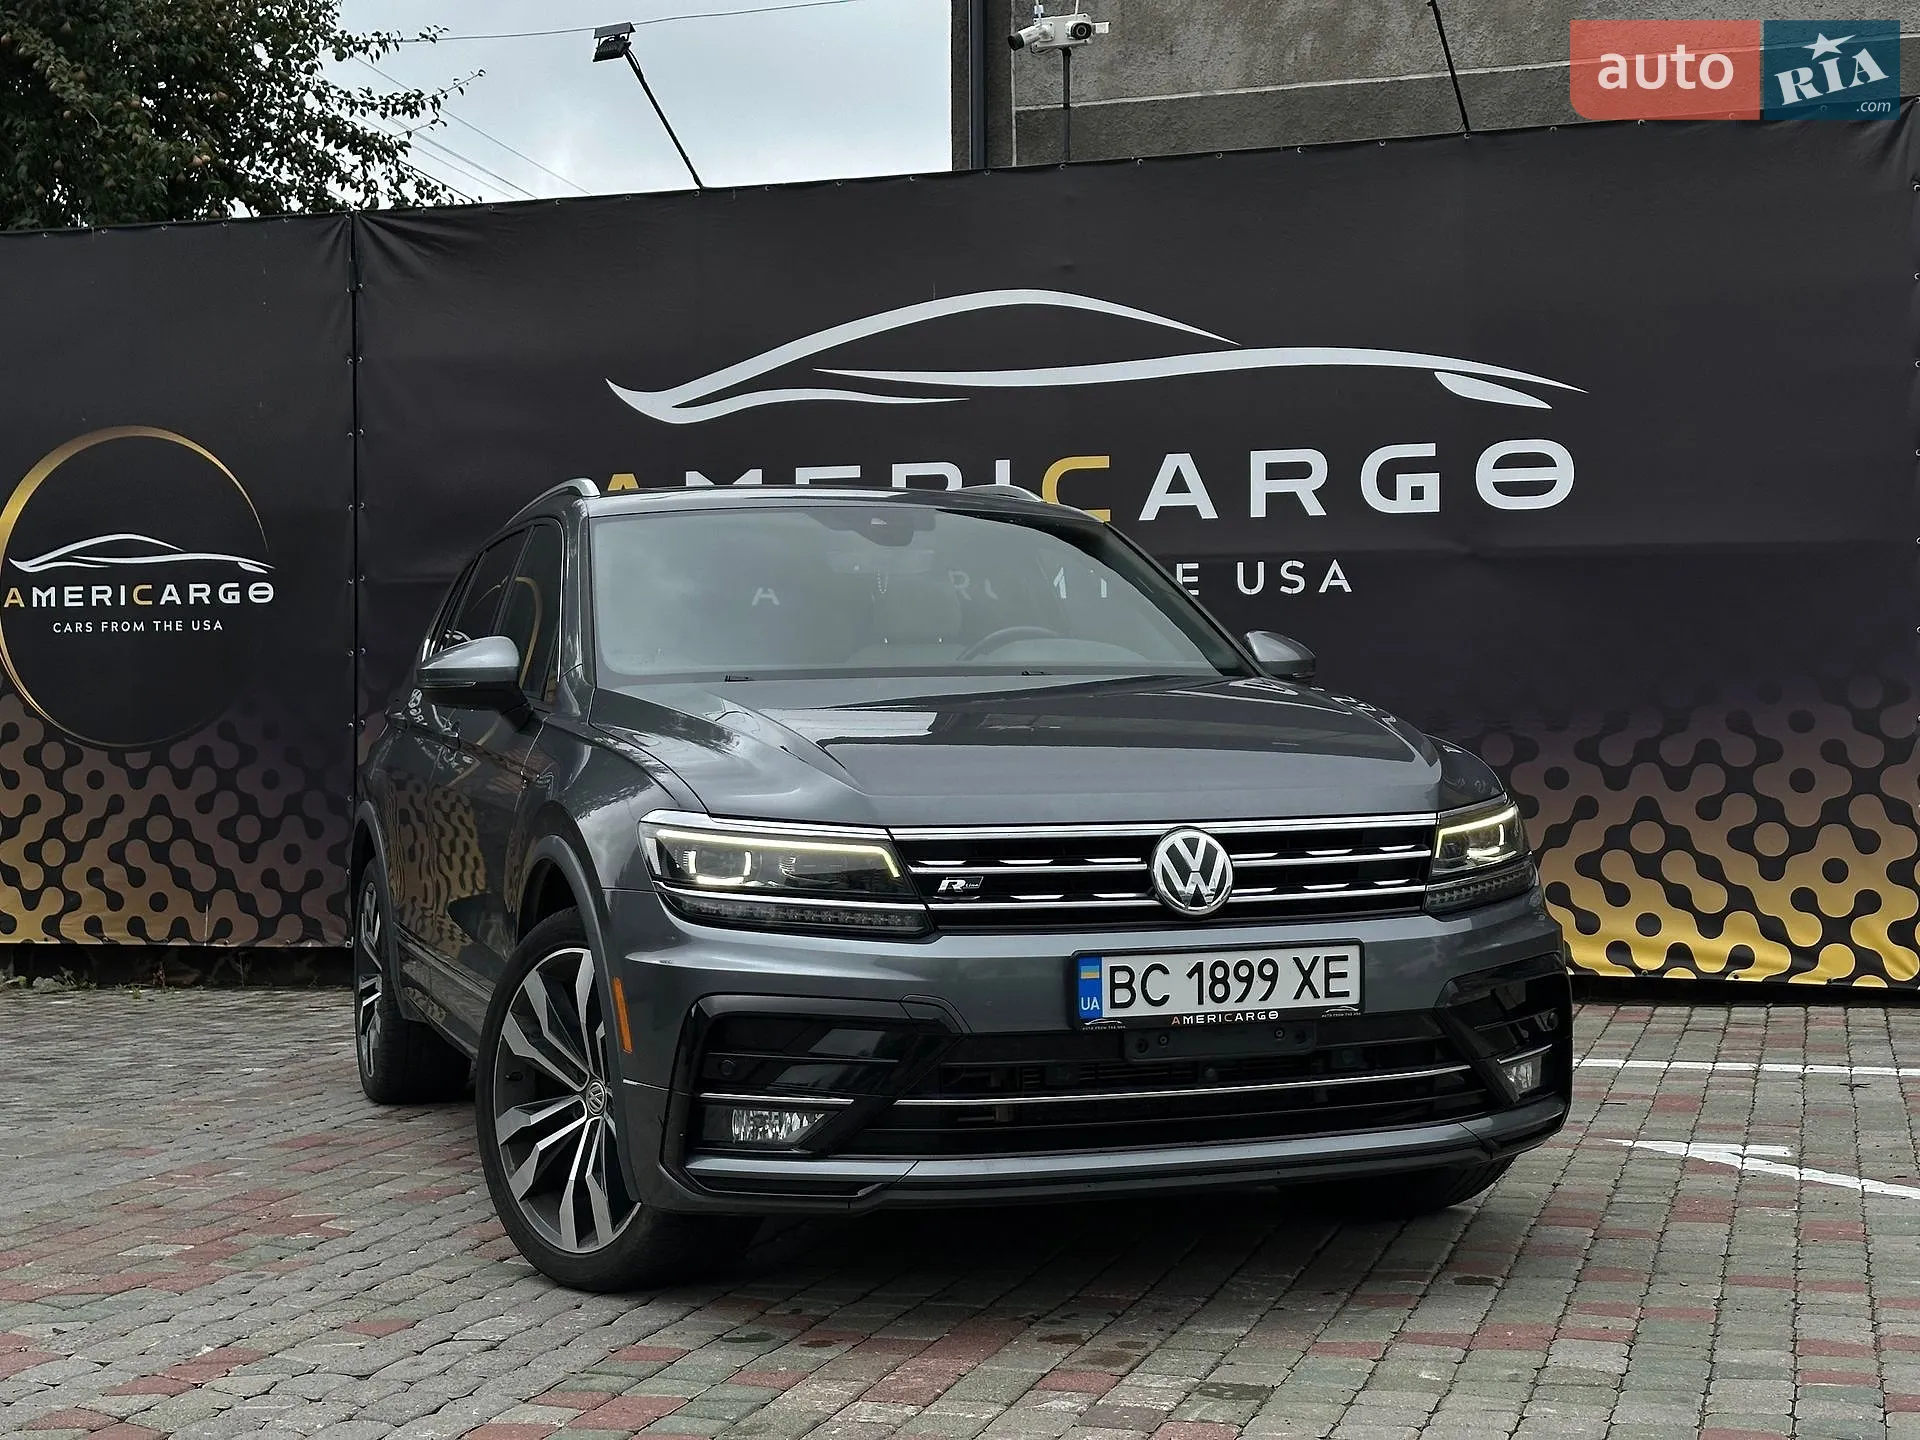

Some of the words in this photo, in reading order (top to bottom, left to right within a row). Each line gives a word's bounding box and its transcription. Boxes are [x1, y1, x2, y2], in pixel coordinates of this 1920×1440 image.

[1236, 559, 1353, 595] USA
[3, 581, 275, 608] AMERICARGO
[52, 621, 93, 634] CARS
[101, 620, 145, 633] FROM
[152, 620, 183, 632] THE
[191, 619, 223, 631] USA
[1109, 963, 1170, 1010] BC
[1186, 957, 1279, 1006] 1899
[1292, 954, 1350, 1000] XE
[1080, 996, 1099, 1011] UA
[1171, 1010, 1279, 1026] AMERICARGO
